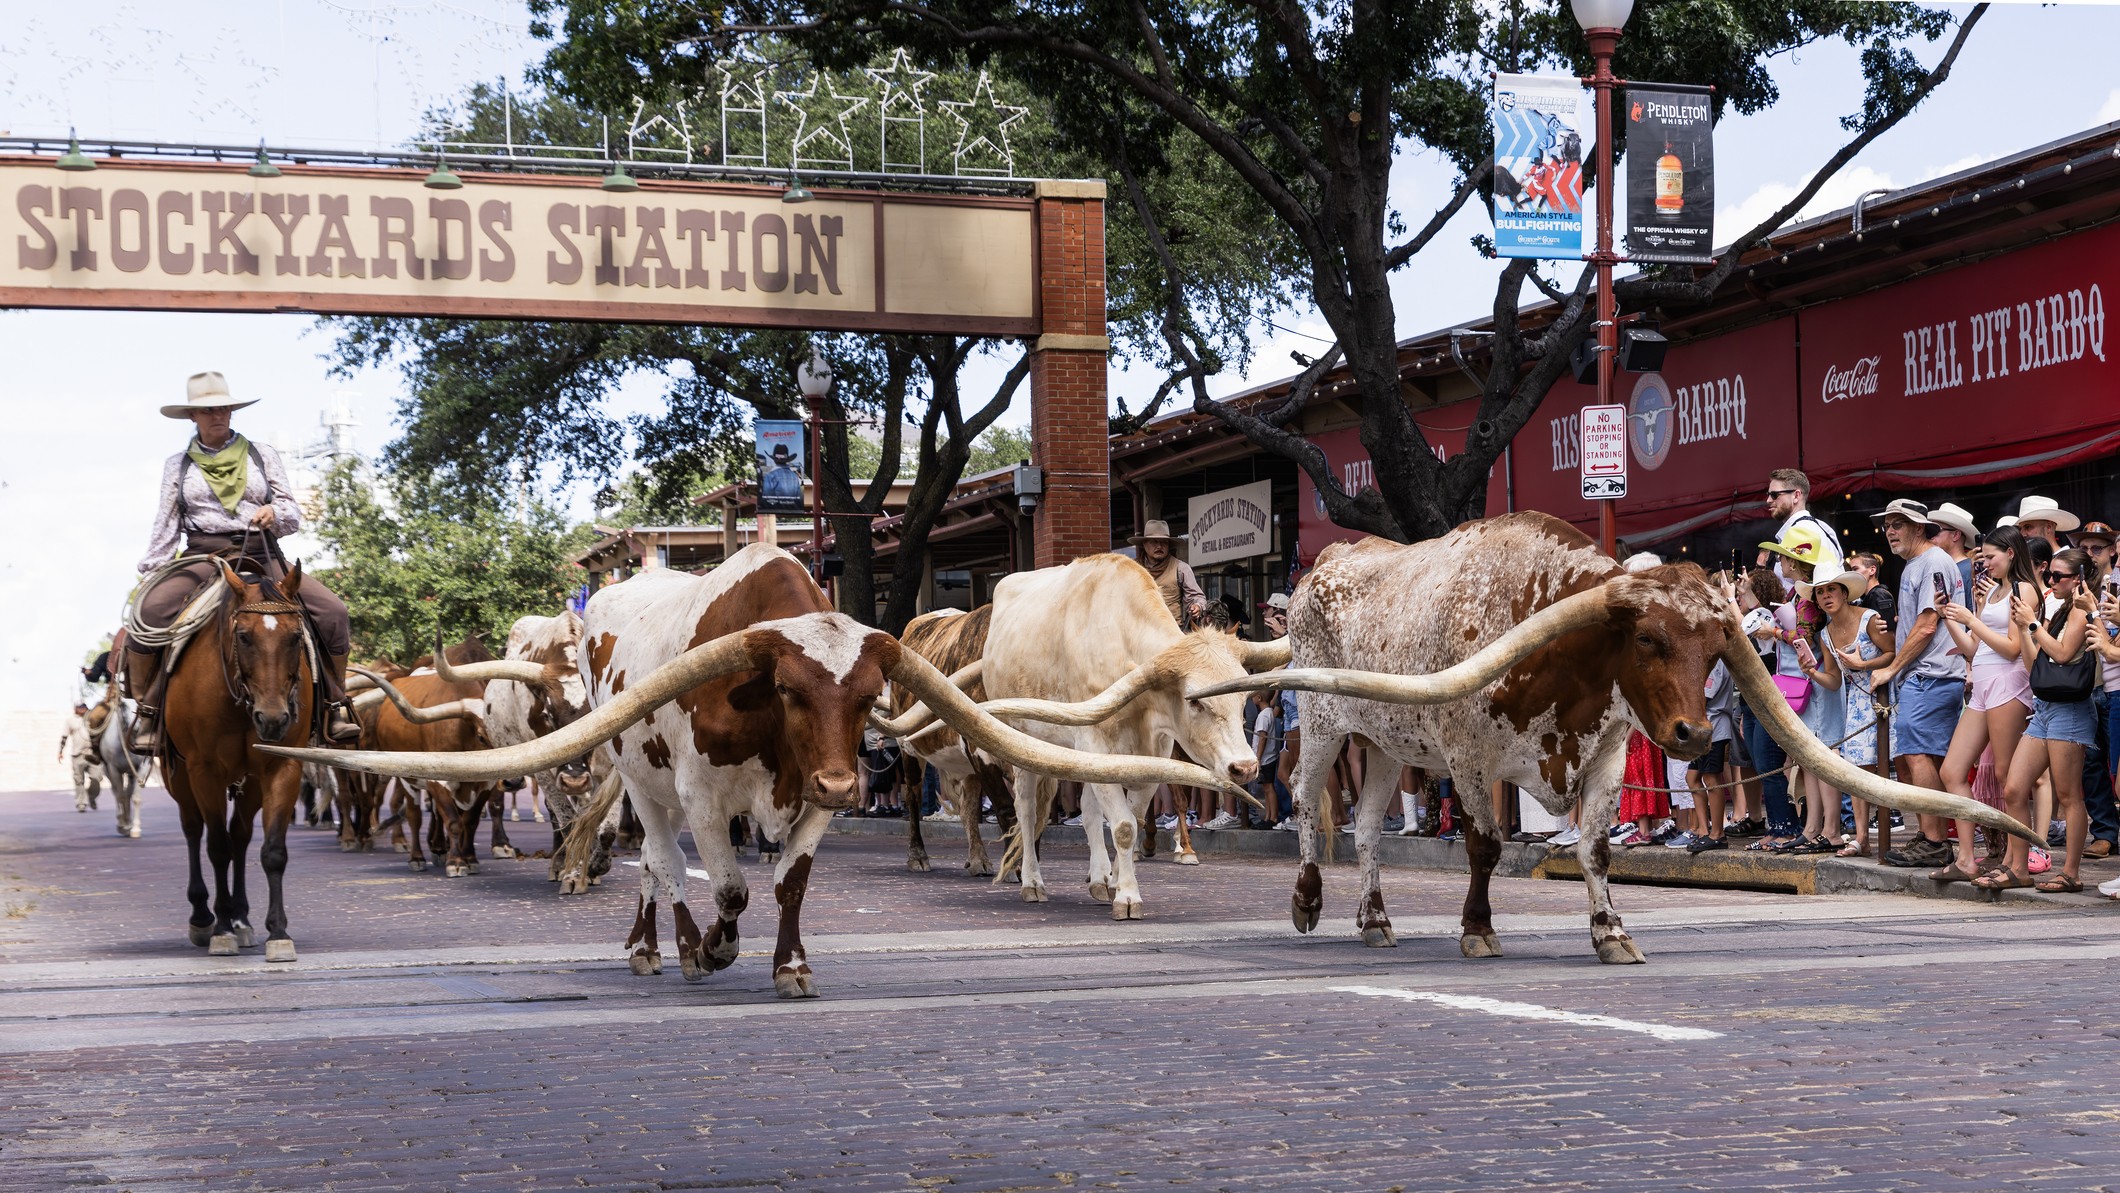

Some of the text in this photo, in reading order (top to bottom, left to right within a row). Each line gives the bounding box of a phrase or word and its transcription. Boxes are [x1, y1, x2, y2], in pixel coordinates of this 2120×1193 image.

[1647, 101, 1708, 121] PENDLETON
[1661, 117, 1694, 125] WHISKY
[1505, 211, 1573, 220] AMERICAN STYLE
[1496, 220, 1581, 231] BULLFIGHTING
[17, 184, 844, 296] STOCKYARDS STATION
[1903, 320, 1963, 397] REAL
[1970, 305, 2011, 383] PIT
[1822, 355, 1881, 403] Coca-Cola
[1597, 414, 1610, 423] NO
[1585, 423, 1622, 434] PARKING
[1586, 433, 1622, 442] STOPPING
[1599, 442, 1609, 450] OR
[1586, 450, 1622, 460] STANDING
[1191, 497, 1267, 548] STOCKYARDS STATION
[1201, 531, 1256, 554] RETAIL & RESTAURANTS
